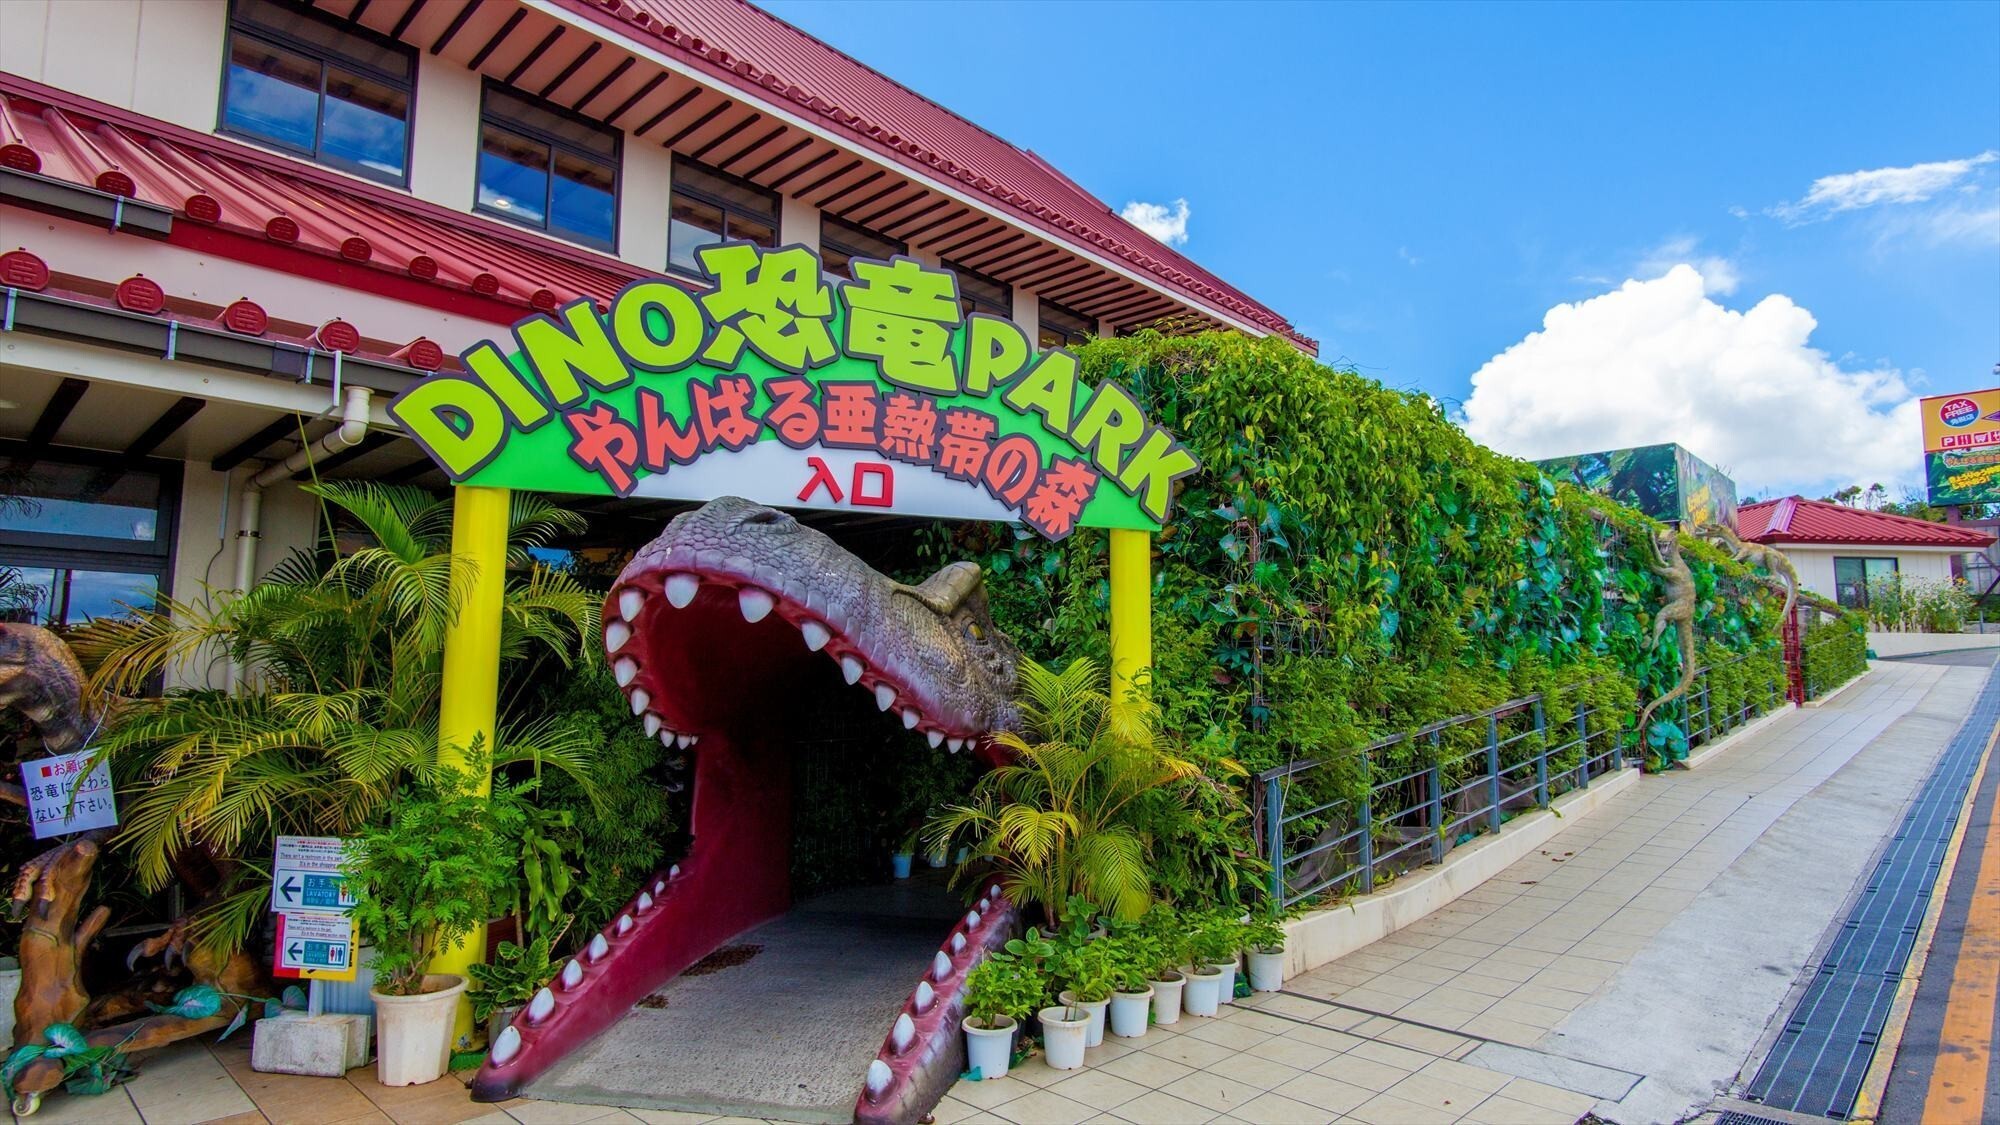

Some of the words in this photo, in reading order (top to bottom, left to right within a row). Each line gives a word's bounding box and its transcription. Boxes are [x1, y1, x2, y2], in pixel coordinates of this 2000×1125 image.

[1944, 400, 1968, 411] TAX
[1944, 405, 1974, 419] FREE
[565, 377, 1098, 538] やんばる亜熱帯の森
[797, 456, 894, 508] 入口
[306, 889, 336, 898] LAVATORY
